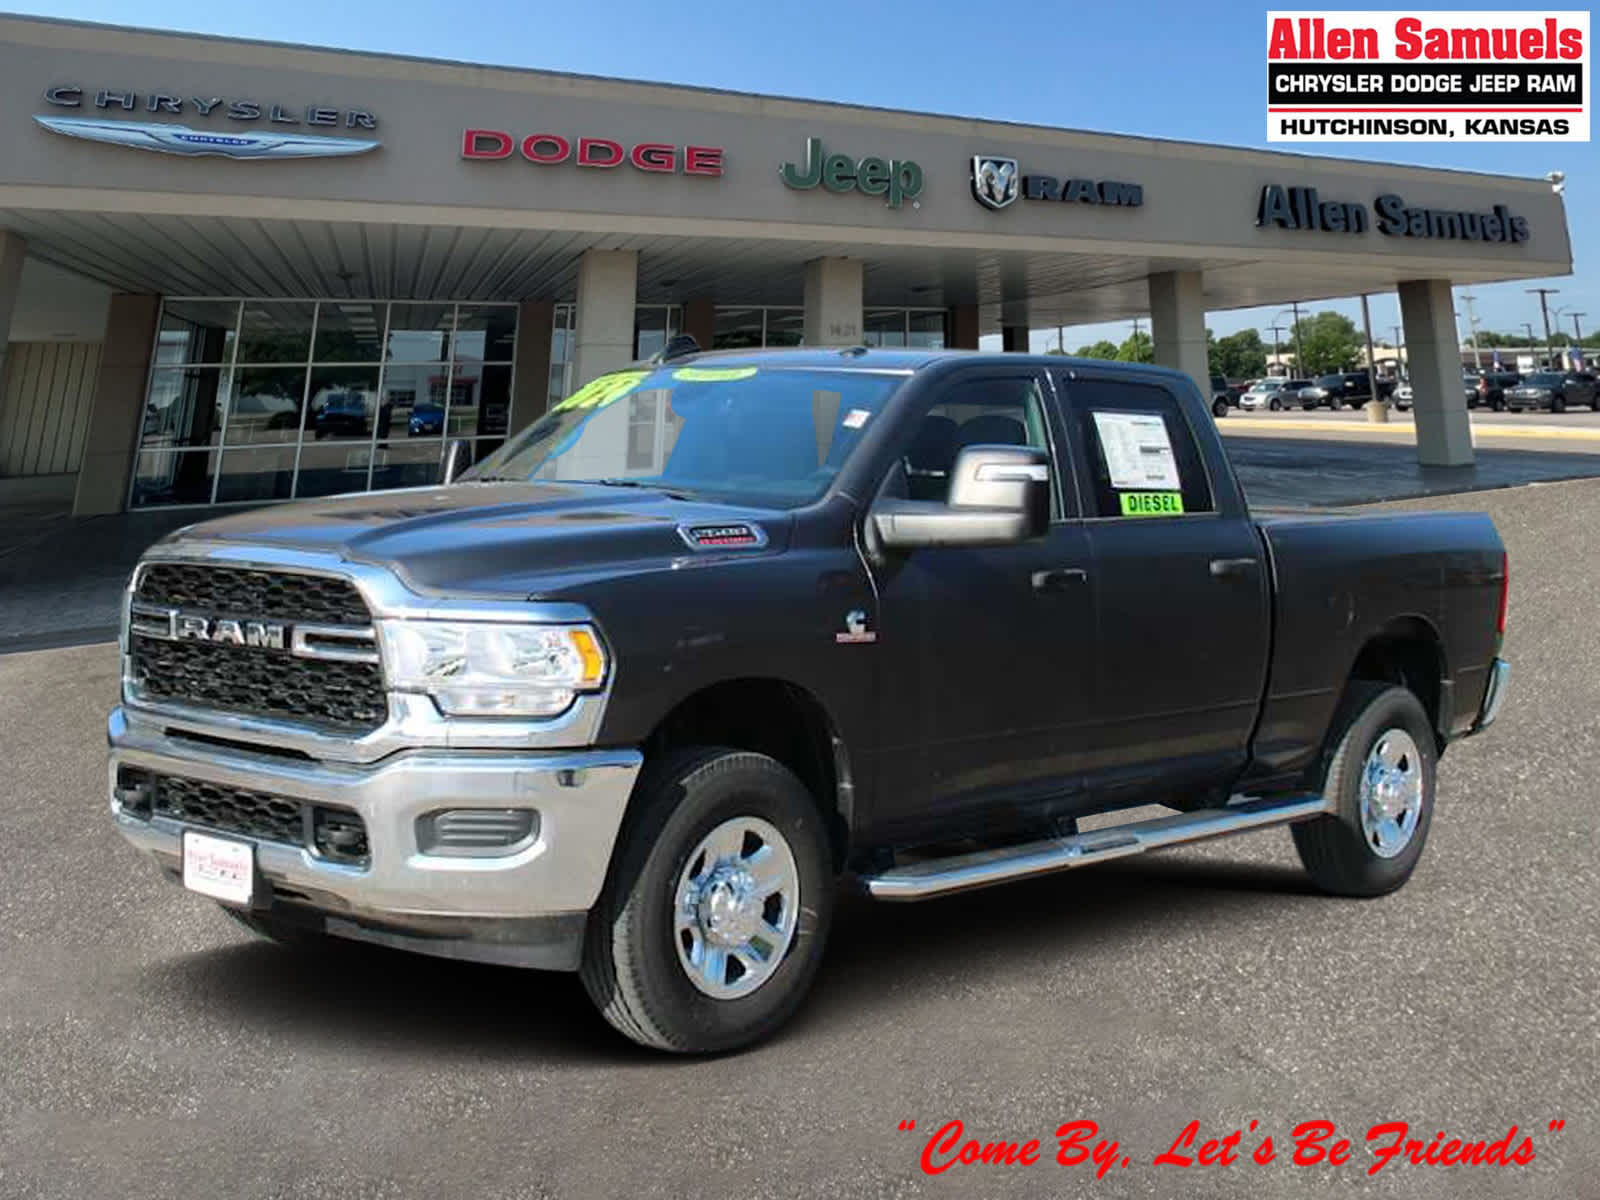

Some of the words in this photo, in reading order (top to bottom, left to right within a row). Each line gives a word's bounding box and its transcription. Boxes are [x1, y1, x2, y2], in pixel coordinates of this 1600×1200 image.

[44, 85, 378, 129] CHRYSLER
[461, 128, 725, 177] DODGE
[780, 136, 924, 209] Jeep
[1022, 174, 1144, 208] RAM
[1255, 184, 1369, 233] Allen
[1373, 193, 1531, 243] Samuels
[1127, 495, 1179, 513] DIESEL
[180, 615, 284, 649] RAM
